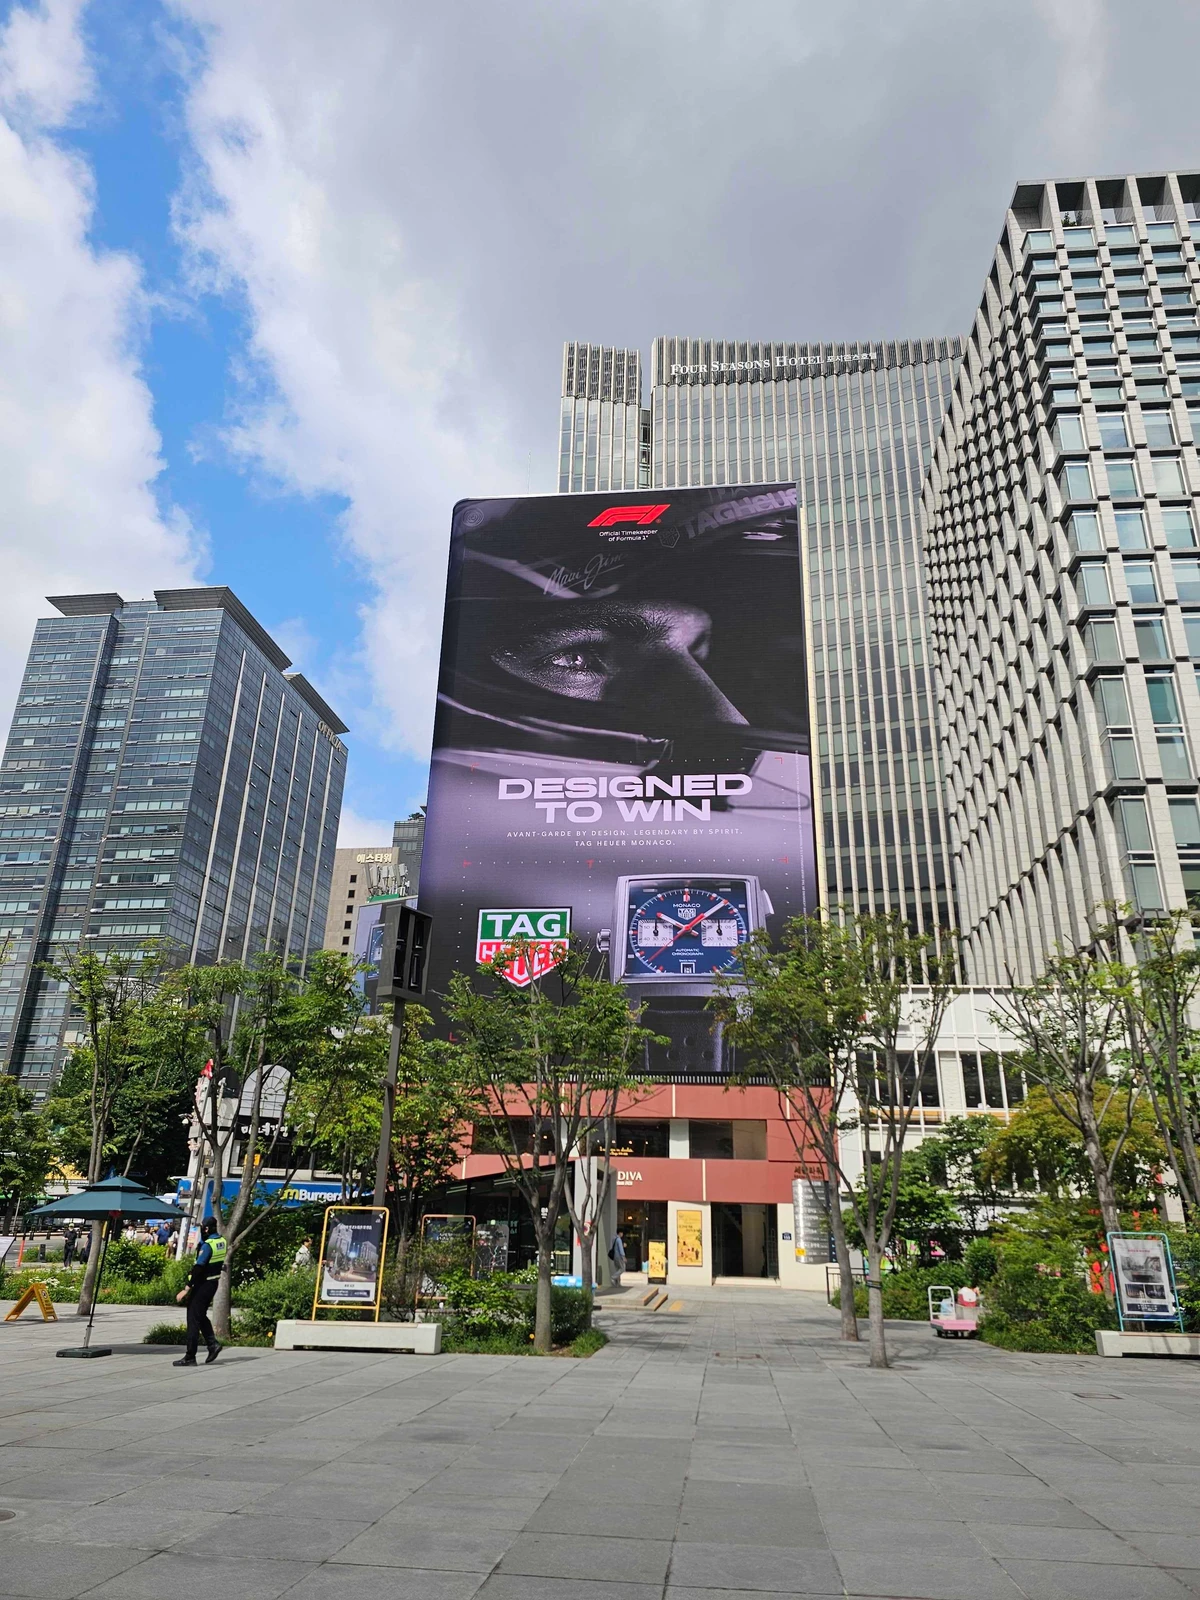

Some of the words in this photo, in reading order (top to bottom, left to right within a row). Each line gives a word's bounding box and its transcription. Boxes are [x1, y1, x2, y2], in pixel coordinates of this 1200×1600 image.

[670, 363, 708, 376] FOUR
[711, 360, 770, 372] SEASONS
[775, 355, 825, 367] HOTEL
[599, 530, 621, 538] Official
[621, 529, 658, 537] Timekeeper
[498, 774, 753, 800] DESIGNED
[535, 800, 603, 823] TO
[616, 798, 711, 822] WIN
[591, 829, 629, 837] DESIGN.
[633, 828, 689, 836] LEGENDARY
[596, 839, 626, 847] HEUER
[486, 913, 561, 938] TAG
